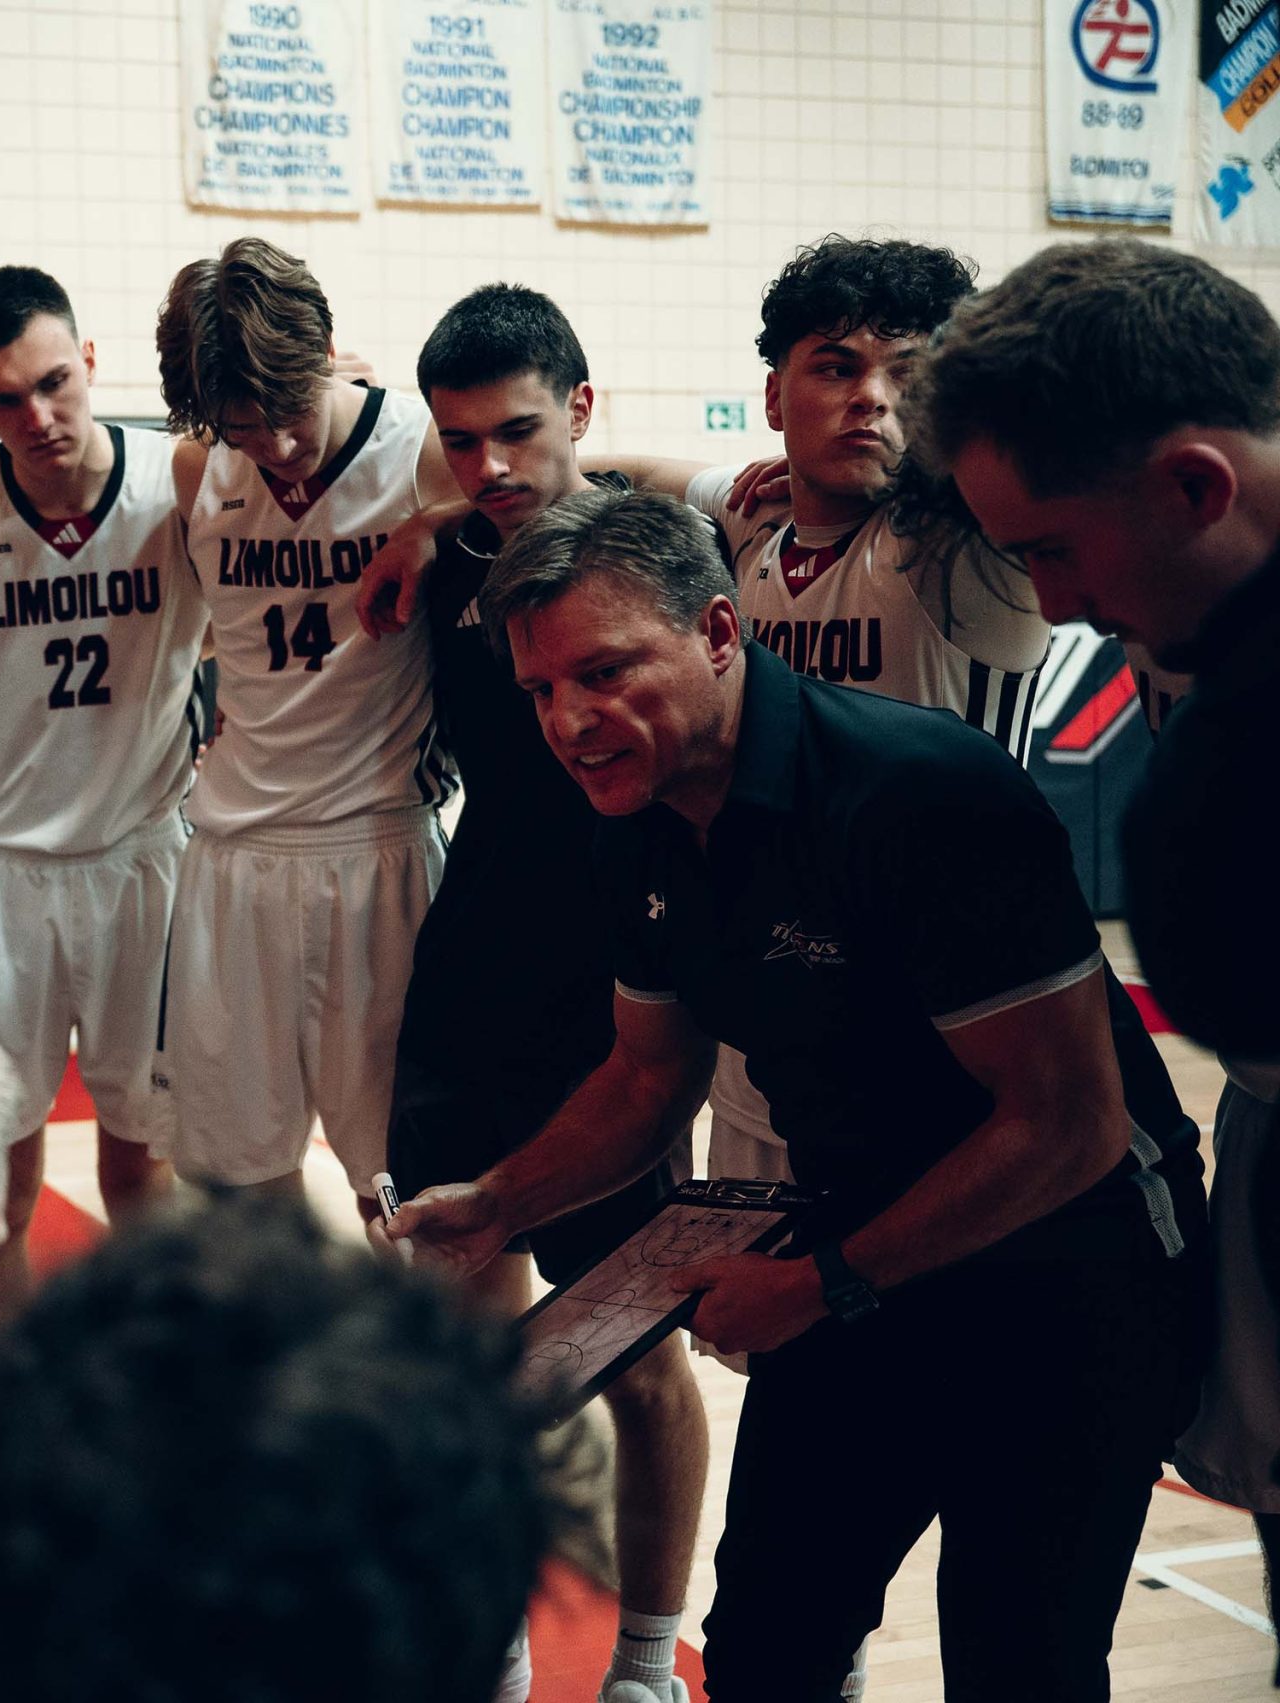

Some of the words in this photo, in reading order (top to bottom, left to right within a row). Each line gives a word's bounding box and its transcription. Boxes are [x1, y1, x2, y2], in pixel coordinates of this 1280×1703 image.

[601, 22, 661, 49] 1992
[1216, 0, 1270, 45] BADM
[208, 73, 336, 107] CHAMPIONS
[402, 82, 512, 110] CHAMPION
[194, 106, 349, 138] CHAMPIONNES
[402, 112, 512, 140] CHAMPION
[574, 118, 695, 146] CHAMPION
[263, 602, 337, 672] 14
[44, 634, 111, 709] 22
